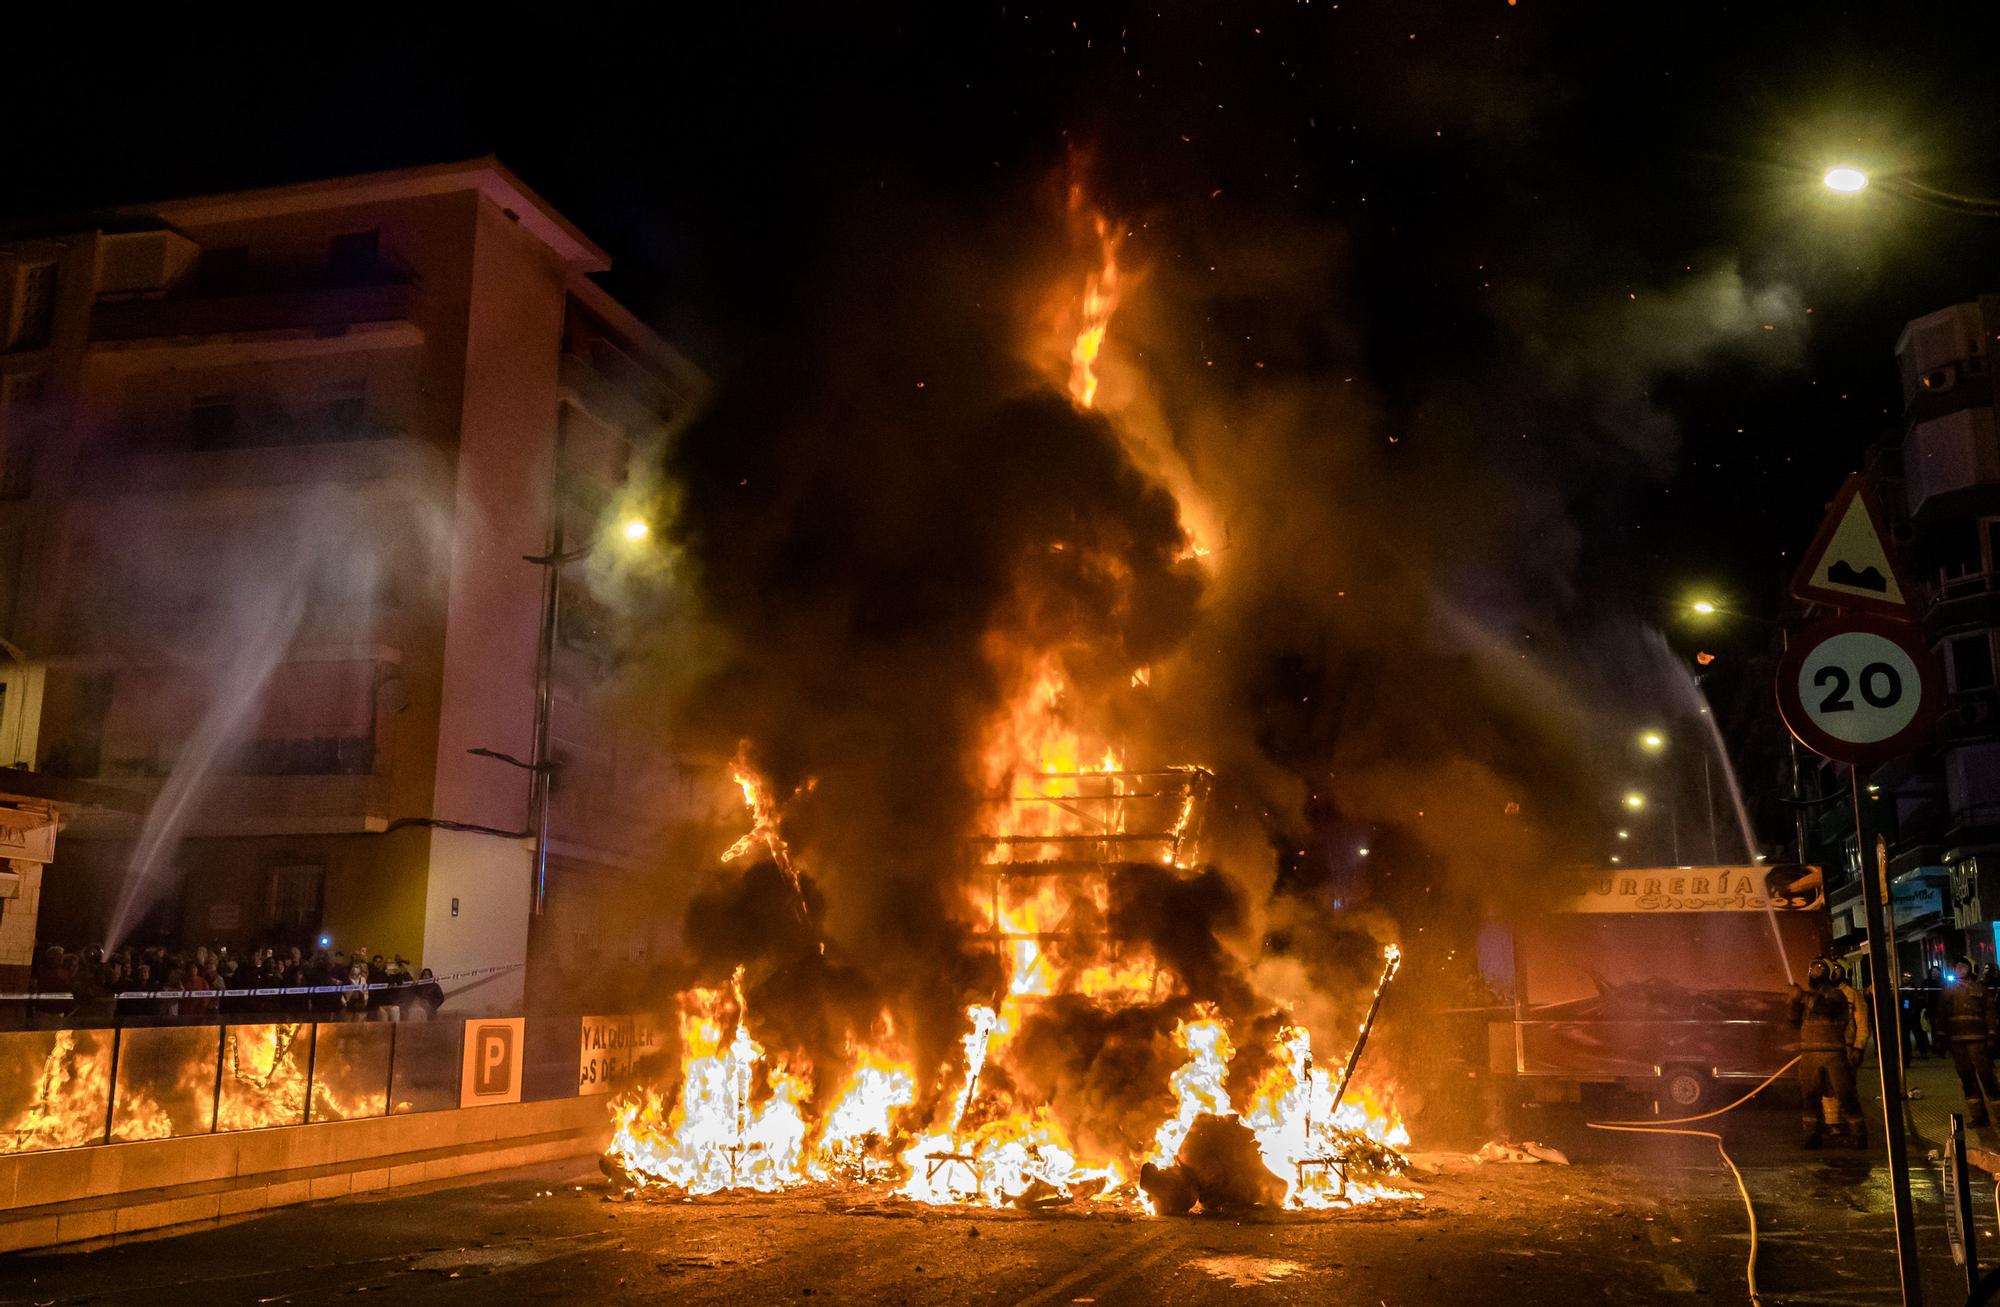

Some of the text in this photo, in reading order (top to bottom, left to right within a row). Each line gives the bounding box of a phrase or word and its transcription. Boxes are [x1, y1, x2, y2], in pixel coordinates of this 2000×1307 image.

[1814, 662, 1903, 713] 20
[1595, 870, 1753, 896] URRERÍA
[483, 1036, 505, 1085] P
